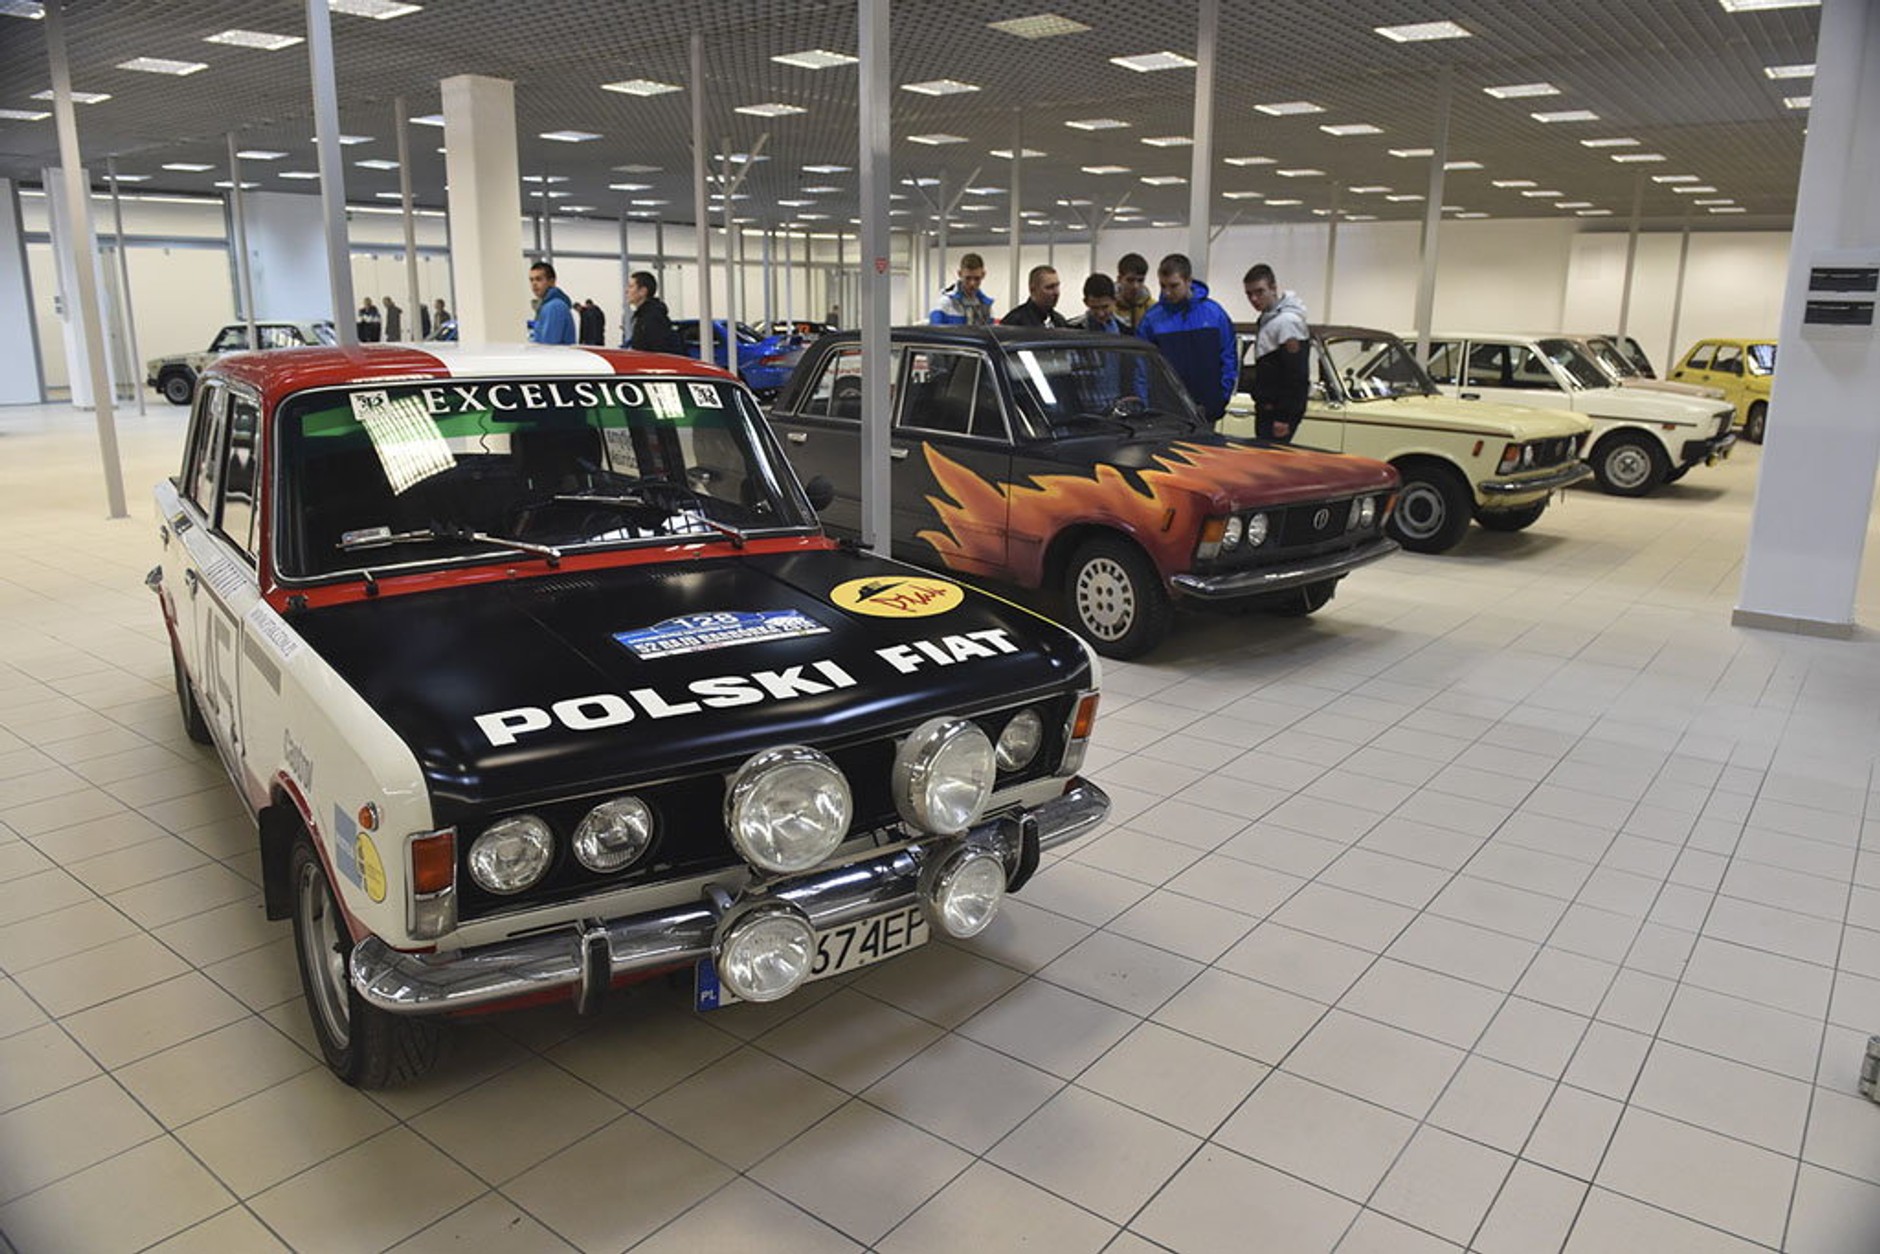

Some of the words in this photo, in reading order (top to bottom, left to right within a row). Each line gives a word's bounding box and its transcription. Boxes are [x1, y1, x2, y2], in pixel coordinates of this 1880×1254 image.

[422, 381, 672, 415] EXCELSIO
[674, 612, 739, 629] 128
[473, 659, 858, 748] POLSKI
[876, 629, 1022, 675] FIAT
[701, 990, 717, 1003] PL
